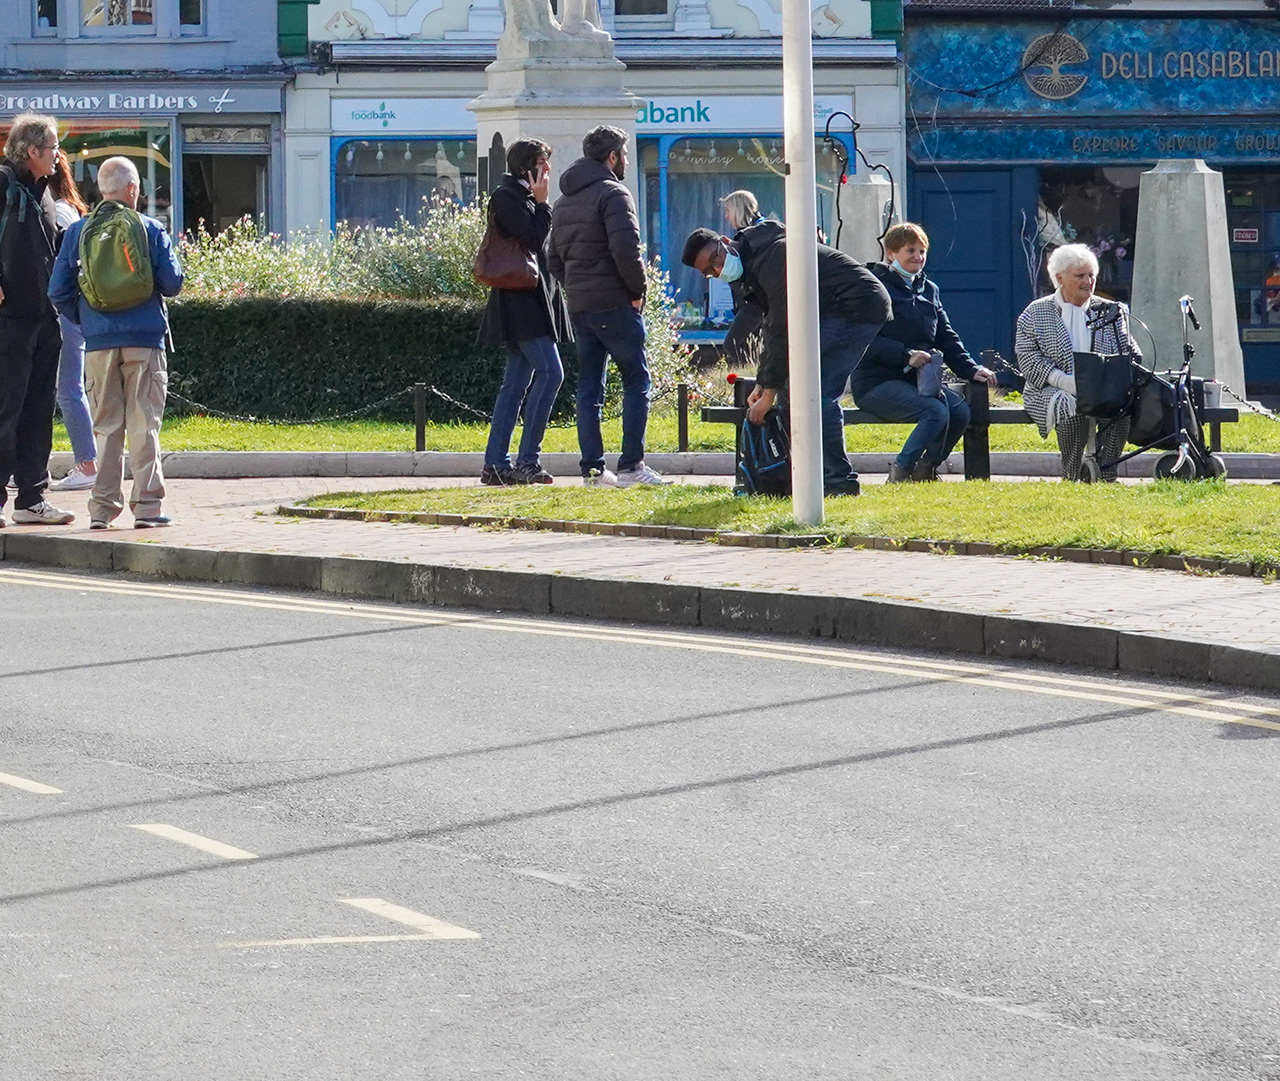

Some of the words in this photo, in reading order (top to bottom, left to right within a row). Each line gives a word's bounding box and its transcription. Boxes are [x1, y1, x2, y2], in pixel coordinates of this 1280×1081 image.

[1102, 52, 1153, 79] DELI
[1164, 50, 1280, 78] CASABLA
[108, 93, 198, 109] Barbers
[351, 110, 396, 120] foodbank
[635, 100, 710, 124] dbank
[1072, 136, 1139, 154] EXPLORE
[1156, 135, 1218, 152] SAVOUR
